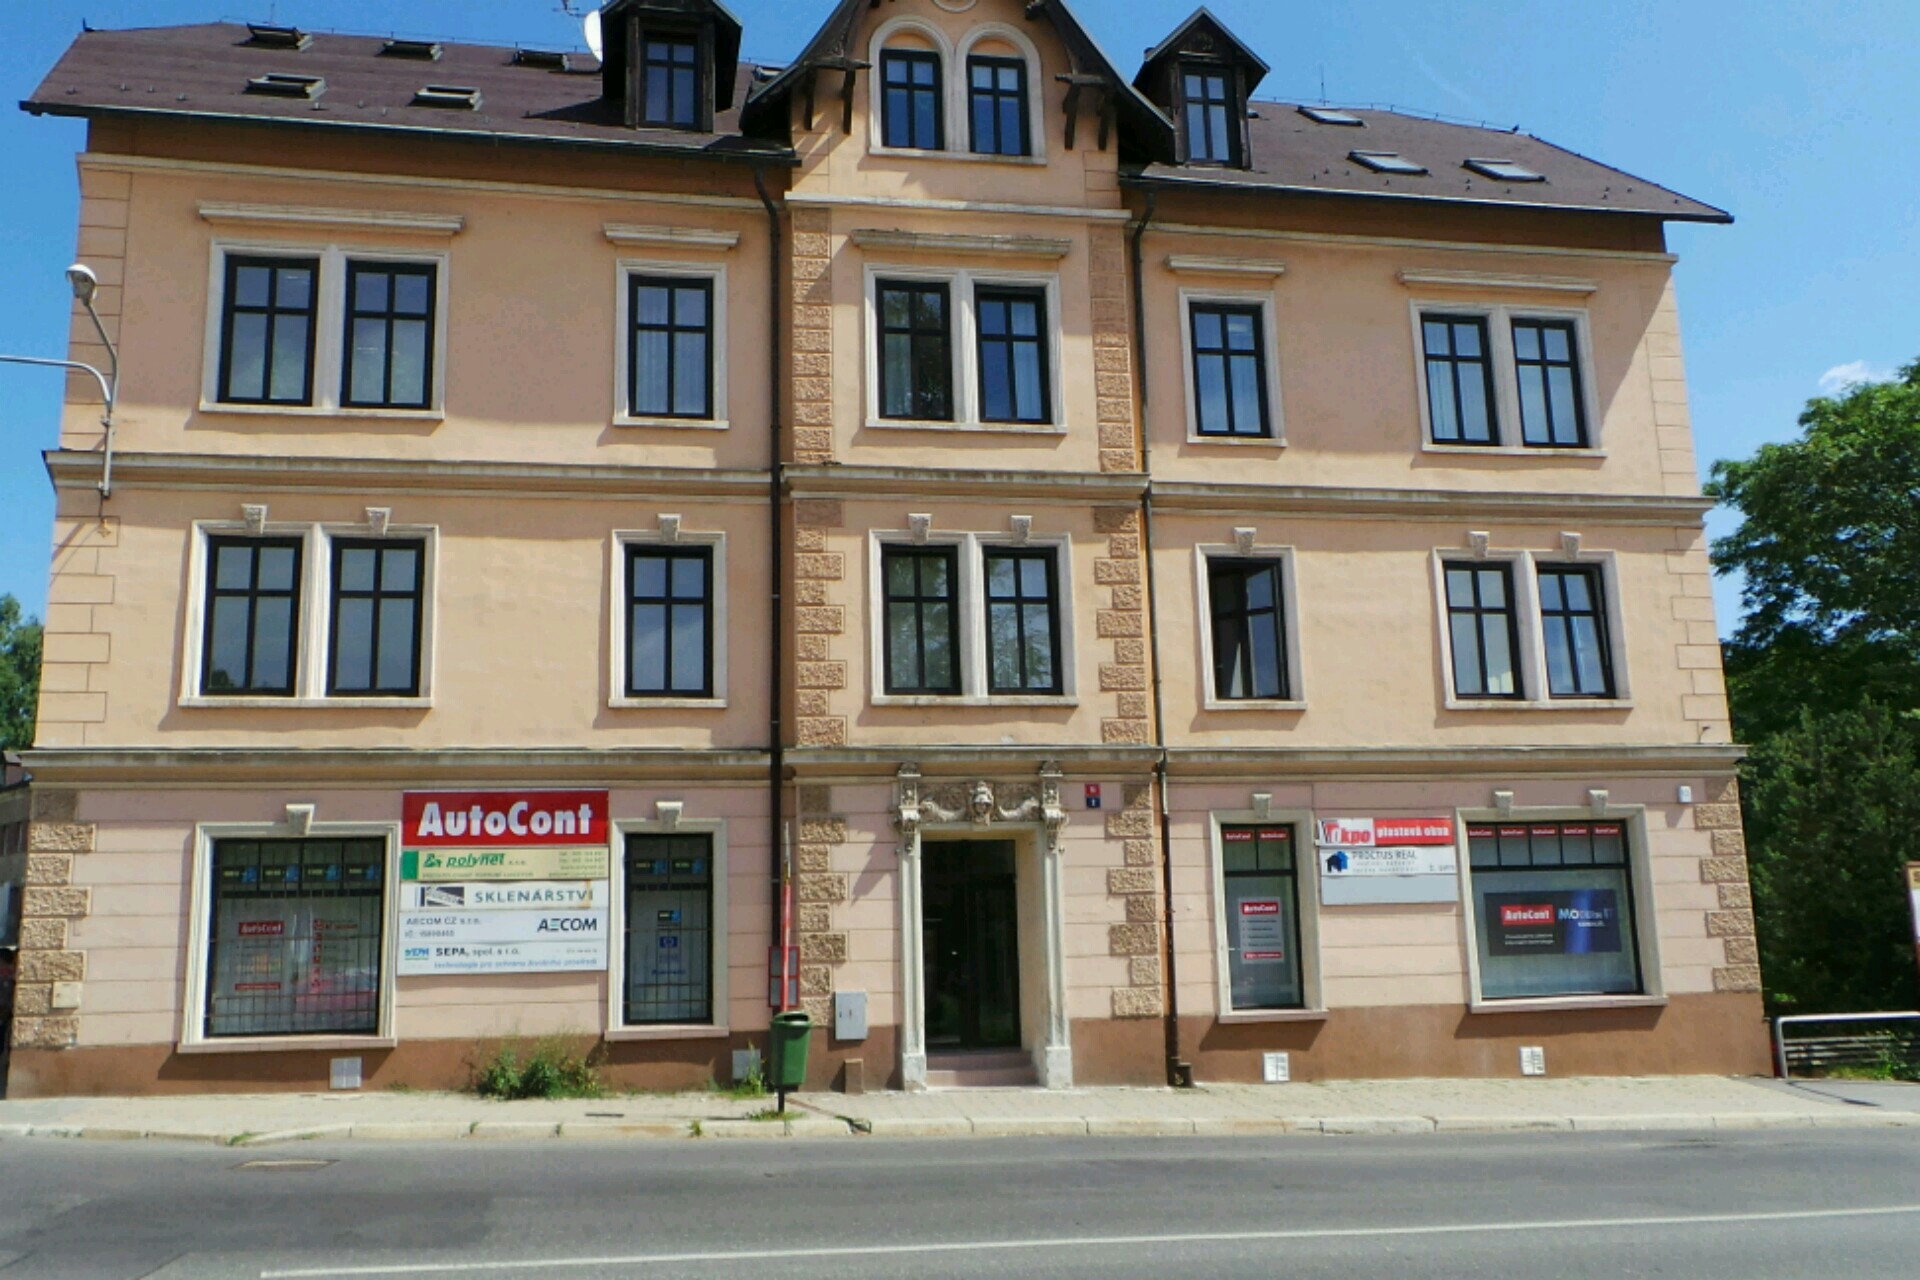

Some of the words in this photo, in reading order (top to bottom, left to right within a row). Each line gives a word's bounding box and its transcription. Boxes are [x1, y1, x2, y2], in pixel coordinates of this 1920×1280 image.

[417, 801, 592, 836] AutoCont
[446, 853, 505, 868] polynet
[1505, 910, 1550, 919] AutoCont
[537, 918, 597, 932] AECOM
